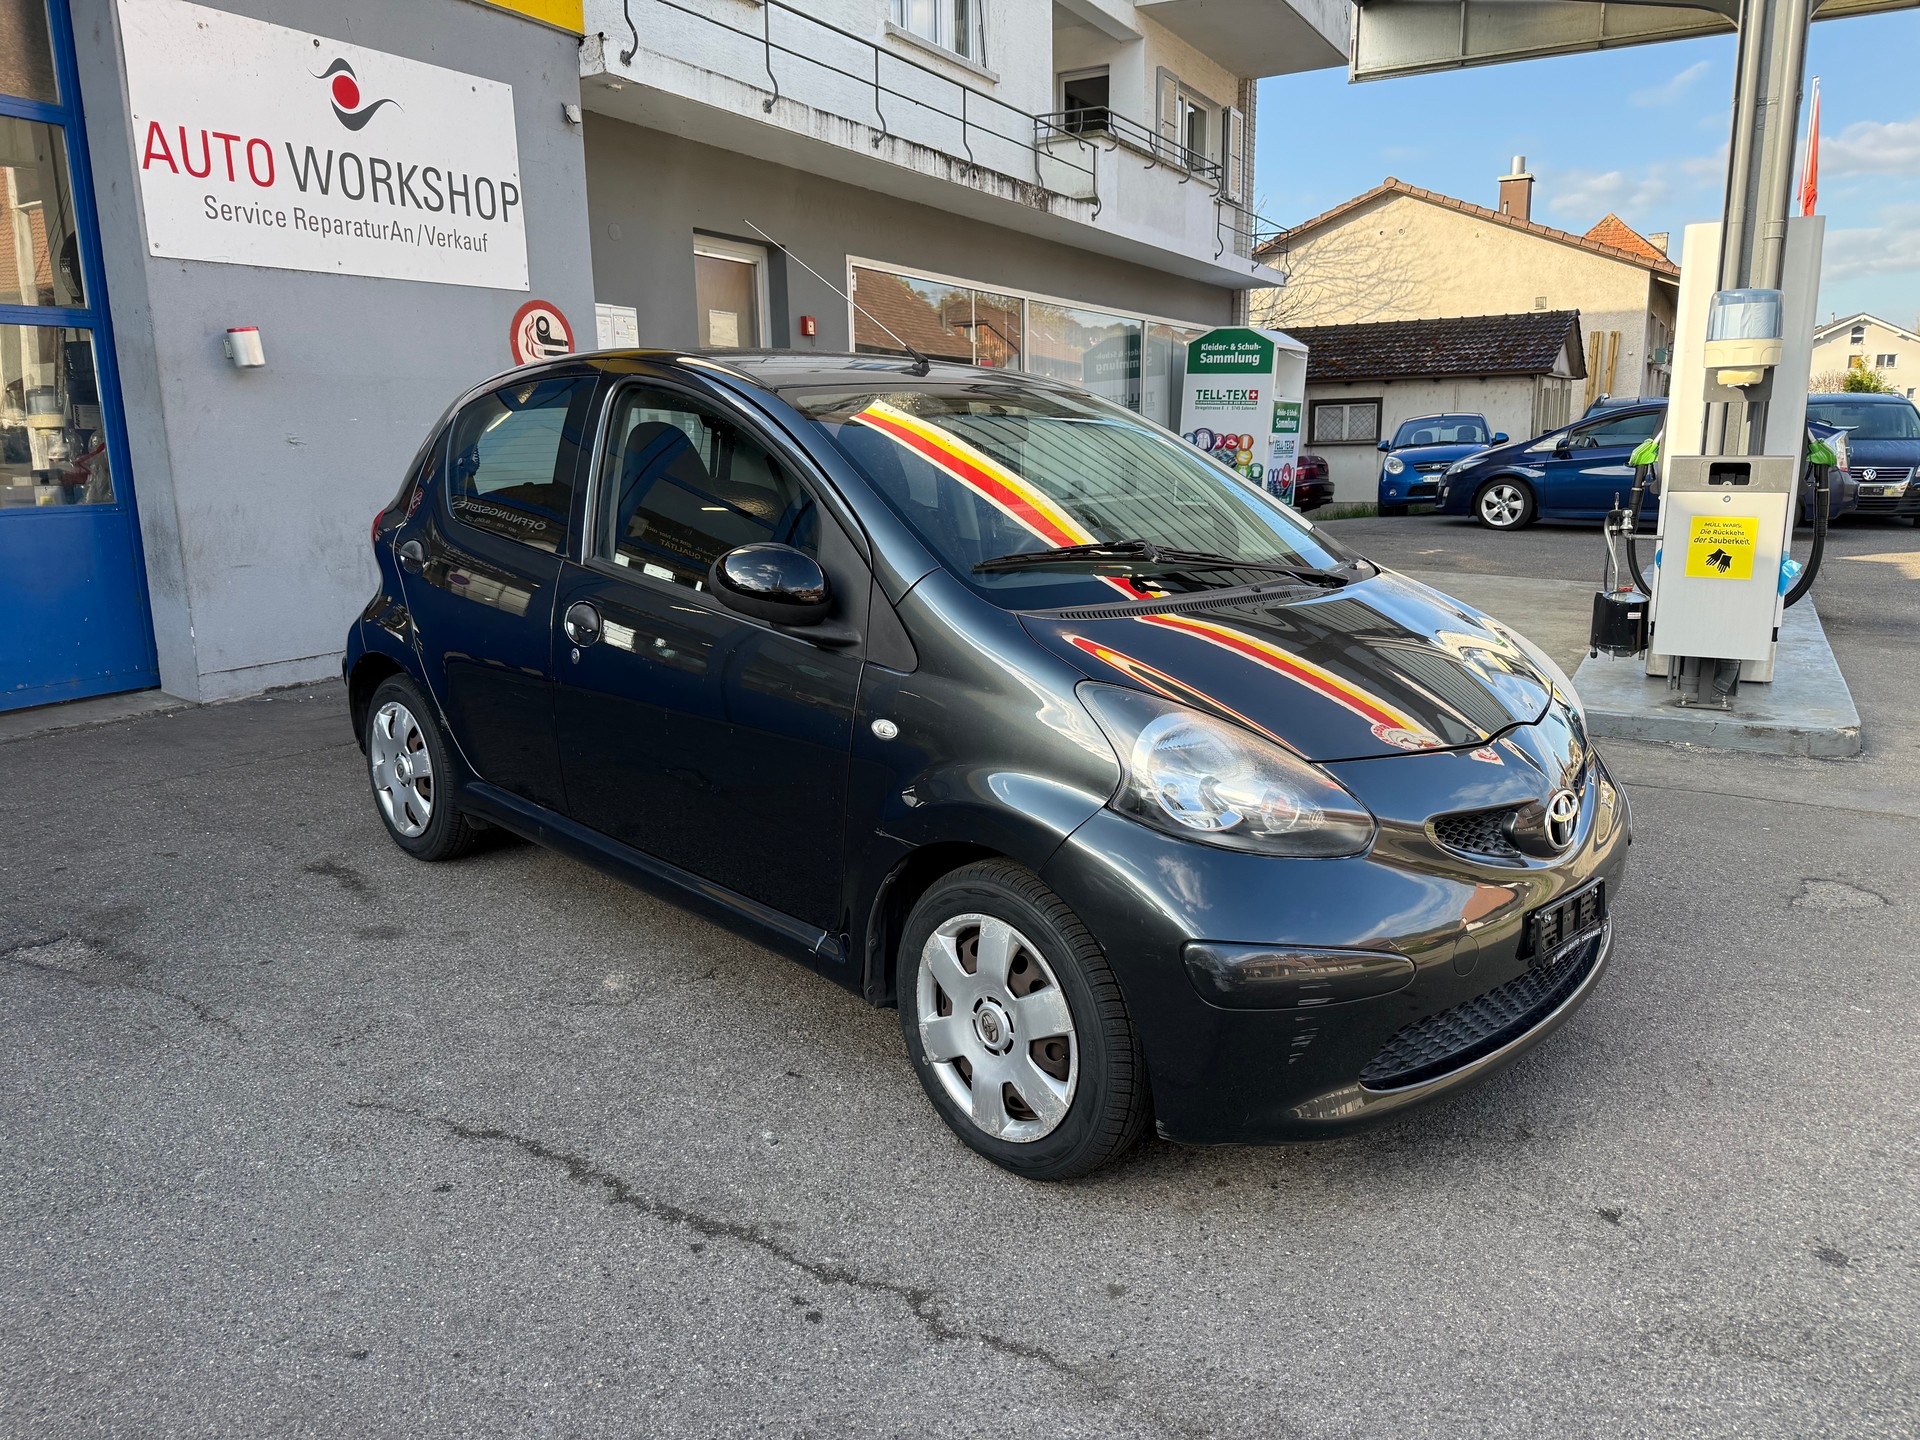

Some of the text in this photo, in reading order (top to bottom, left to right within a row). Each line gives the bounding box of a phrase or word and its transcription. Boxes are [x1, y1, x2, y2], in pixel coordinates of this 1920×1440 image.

[142, 121, 519, 224] AUTO WORKSHOP
[203, 194, 287, 229] Service
[1200, 342, 1262, 351] Kleider- & Schuh-
[1199, 351, 1260, 366] Sammlung
[1195, 389, 1248, 400] TELL-TEX
